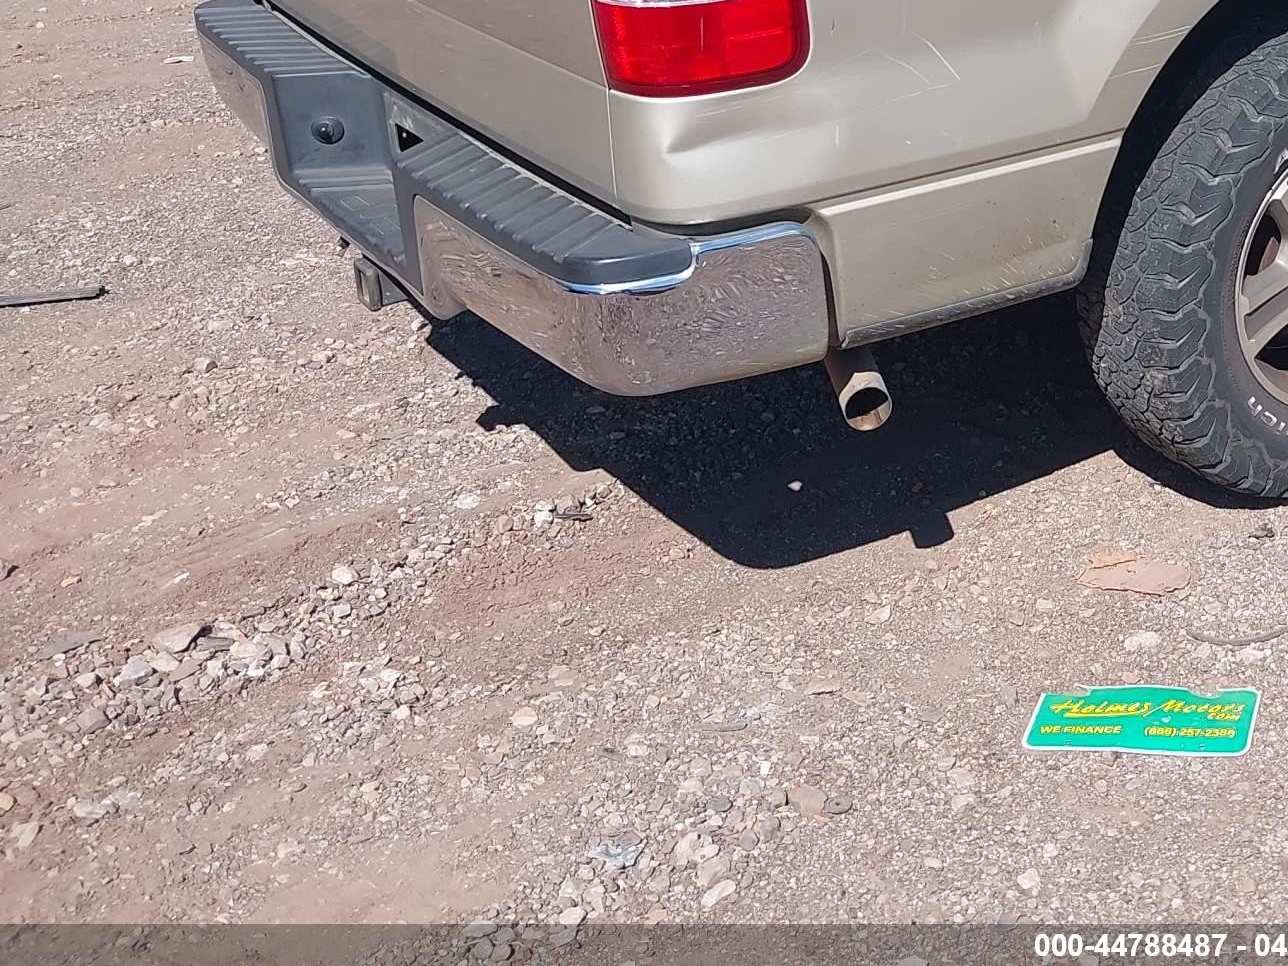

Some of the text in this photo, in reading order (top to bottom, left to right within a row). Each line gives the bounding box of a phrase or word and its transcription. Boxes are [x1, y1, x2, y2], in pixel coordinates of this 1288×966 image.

[1050, 698, 1246, 716] Holmes Motors
[1040, 725, 1122, 734] WE FINANCE
